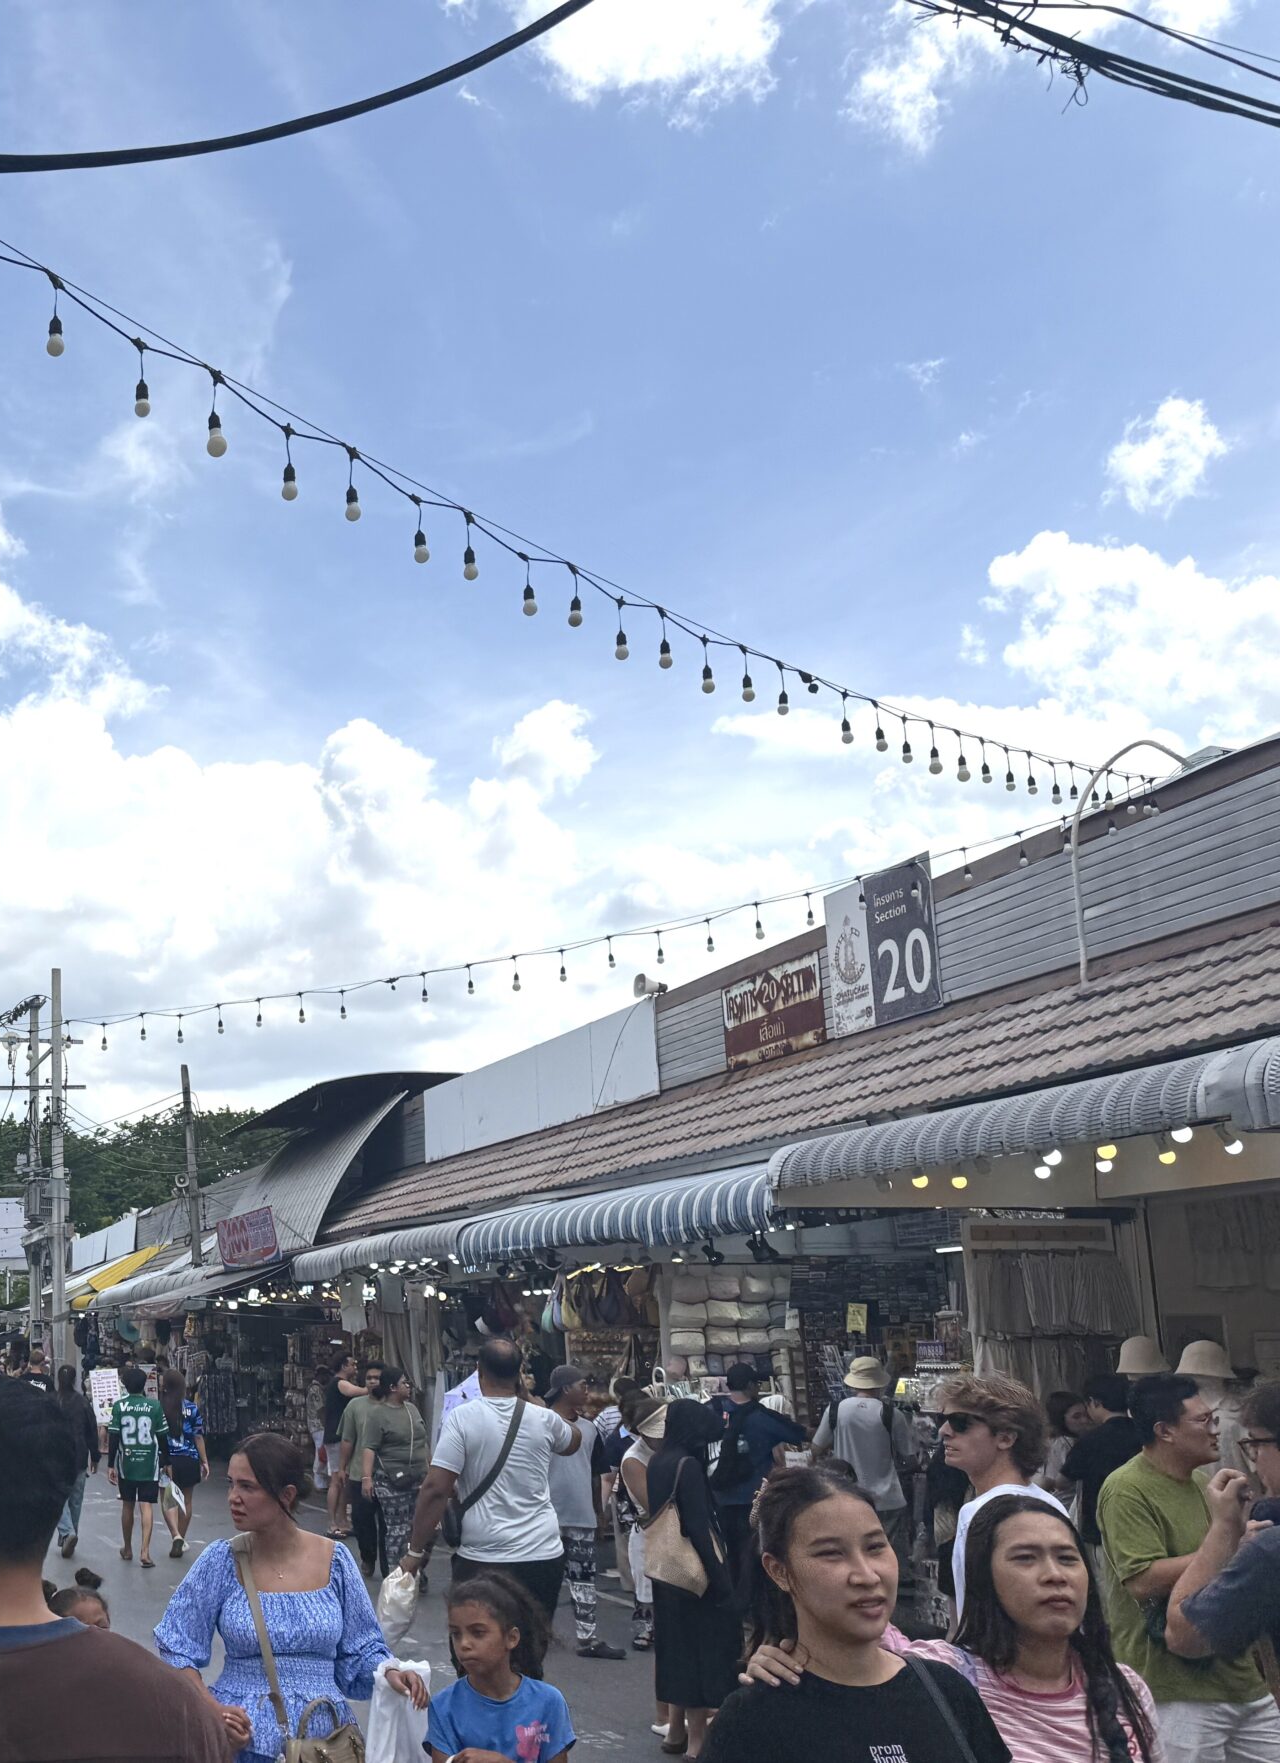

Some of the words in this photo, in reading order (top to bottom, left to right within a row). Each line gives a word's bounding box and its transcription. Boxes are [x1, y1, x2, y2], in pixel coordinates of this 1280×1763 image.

[874, 903, 907, 924] Section
[877, 927, 932, 1005] 20
[761, 979, 778, 1004] 20
[121, 1415, 153, 1445] 28
[869, 1744, 904, 1759] prom
